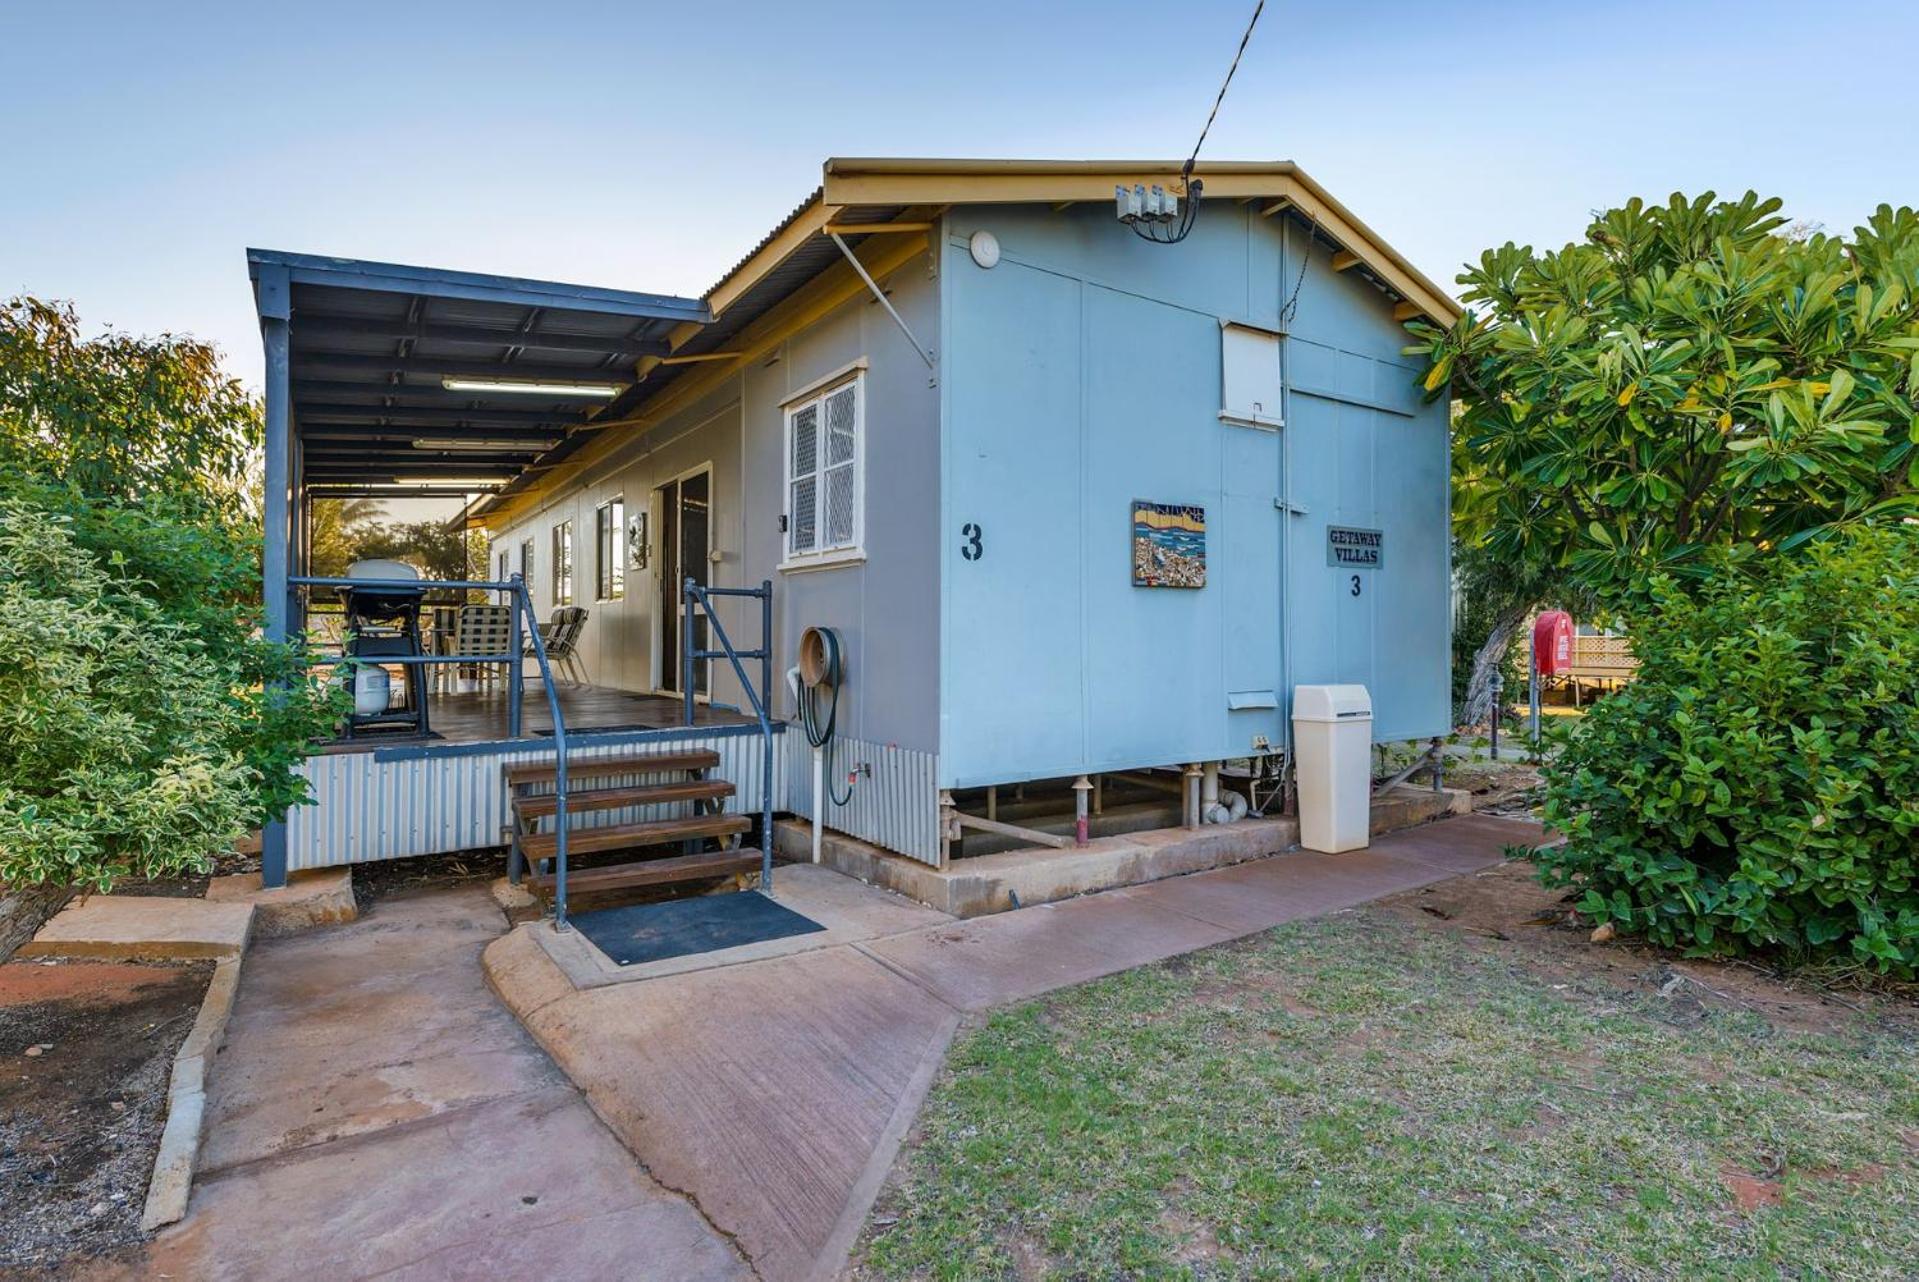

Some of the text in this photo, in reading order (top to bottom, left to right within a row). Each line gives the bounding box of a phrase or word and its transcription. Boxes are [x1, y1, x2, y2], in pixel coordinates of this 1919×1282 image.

[962, 523, 983, 561] 3
[1330, 530, 1382, 546] GETAWAY
[1335, 547, 1378, 562] VILLAS
[1351, 575, 1361, 596] 3
